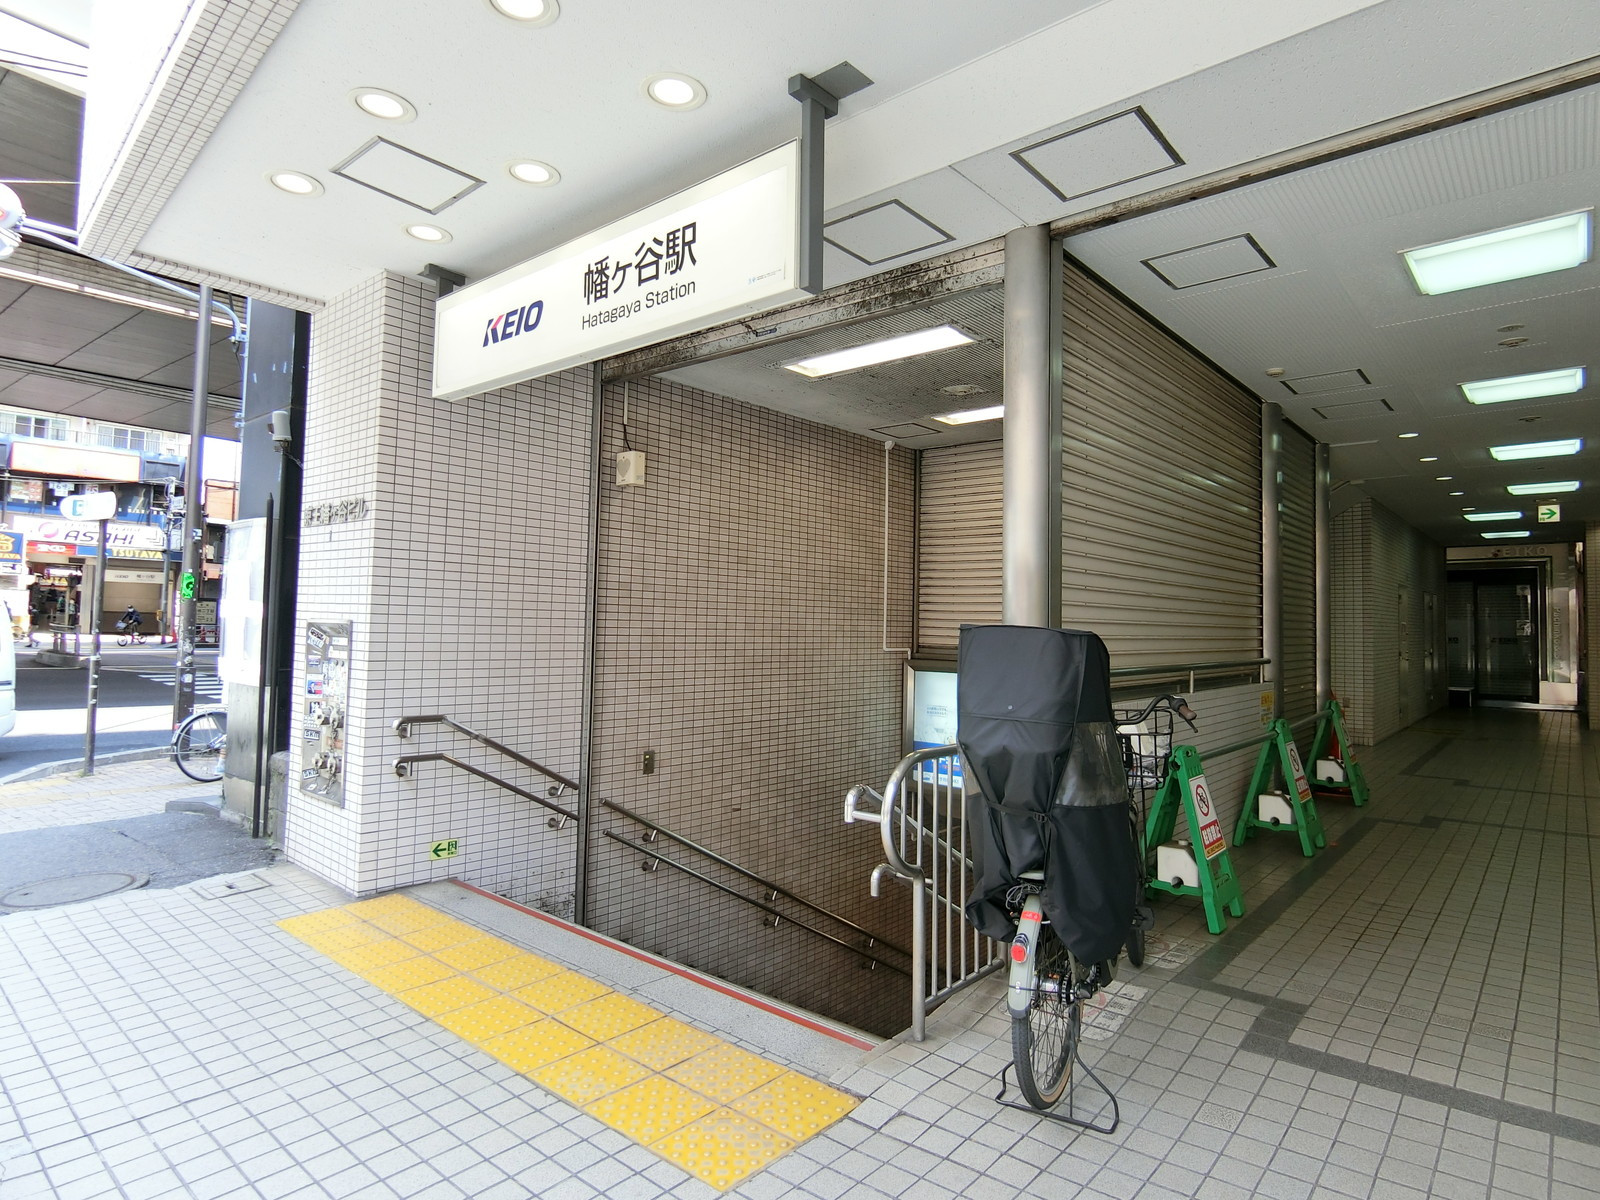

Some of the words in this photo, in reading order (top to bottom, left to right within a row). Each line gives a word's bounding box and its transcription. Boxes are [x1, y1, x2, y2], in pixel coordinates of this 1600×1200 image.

[583, 221, 698, 306] 幡ヶ谷駅
[482, 300, 544, 347] KEIO
[582, 298, 642, 331] Hatagaya
[645, 280, 696, 311] Station
[111, 547, 164, 560] TSUTAYA
